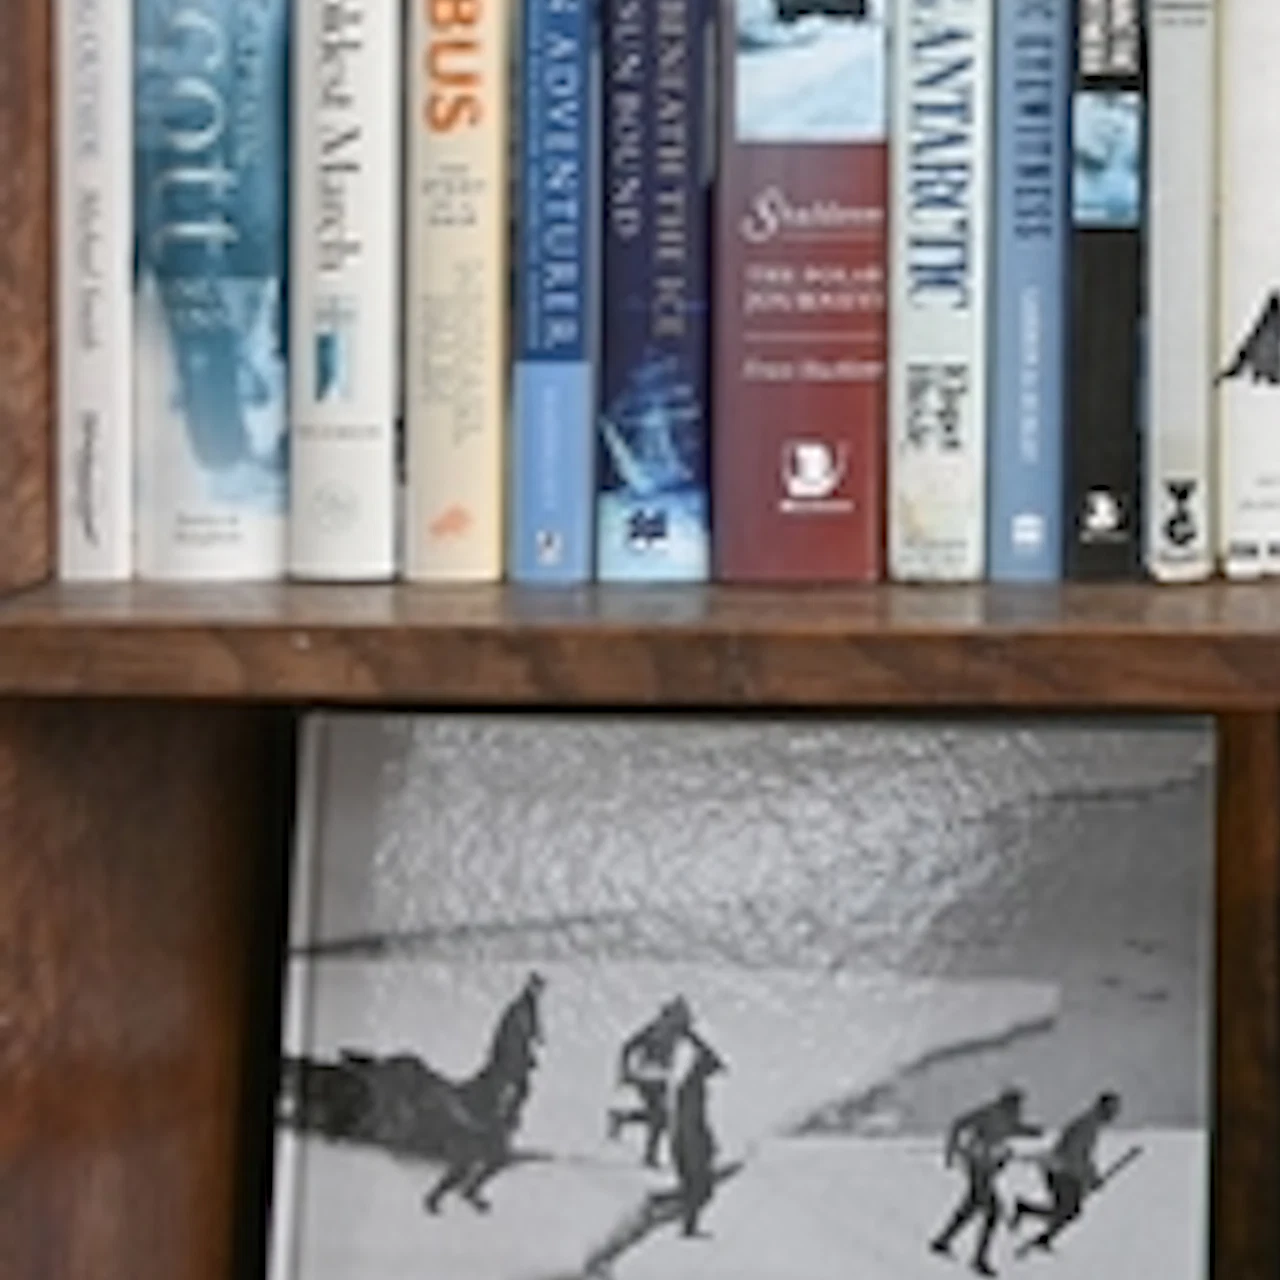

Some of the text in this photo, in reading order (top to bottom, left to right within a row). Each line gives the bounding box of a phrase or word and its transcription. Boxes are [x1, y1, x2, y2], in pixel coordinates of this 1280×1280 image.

[611, 92, 640, 238] BOUND
[655, 0, 688, 176] BENEATH
[911, 18, 976, 312] ANTARCTIC
[1014, 35, 1056, 241] EYEWITNESS
[314, 125, 366, 274] March
[543, 30, 582, 349] ADVENTURER
[653, 191, 685, 264] THE
